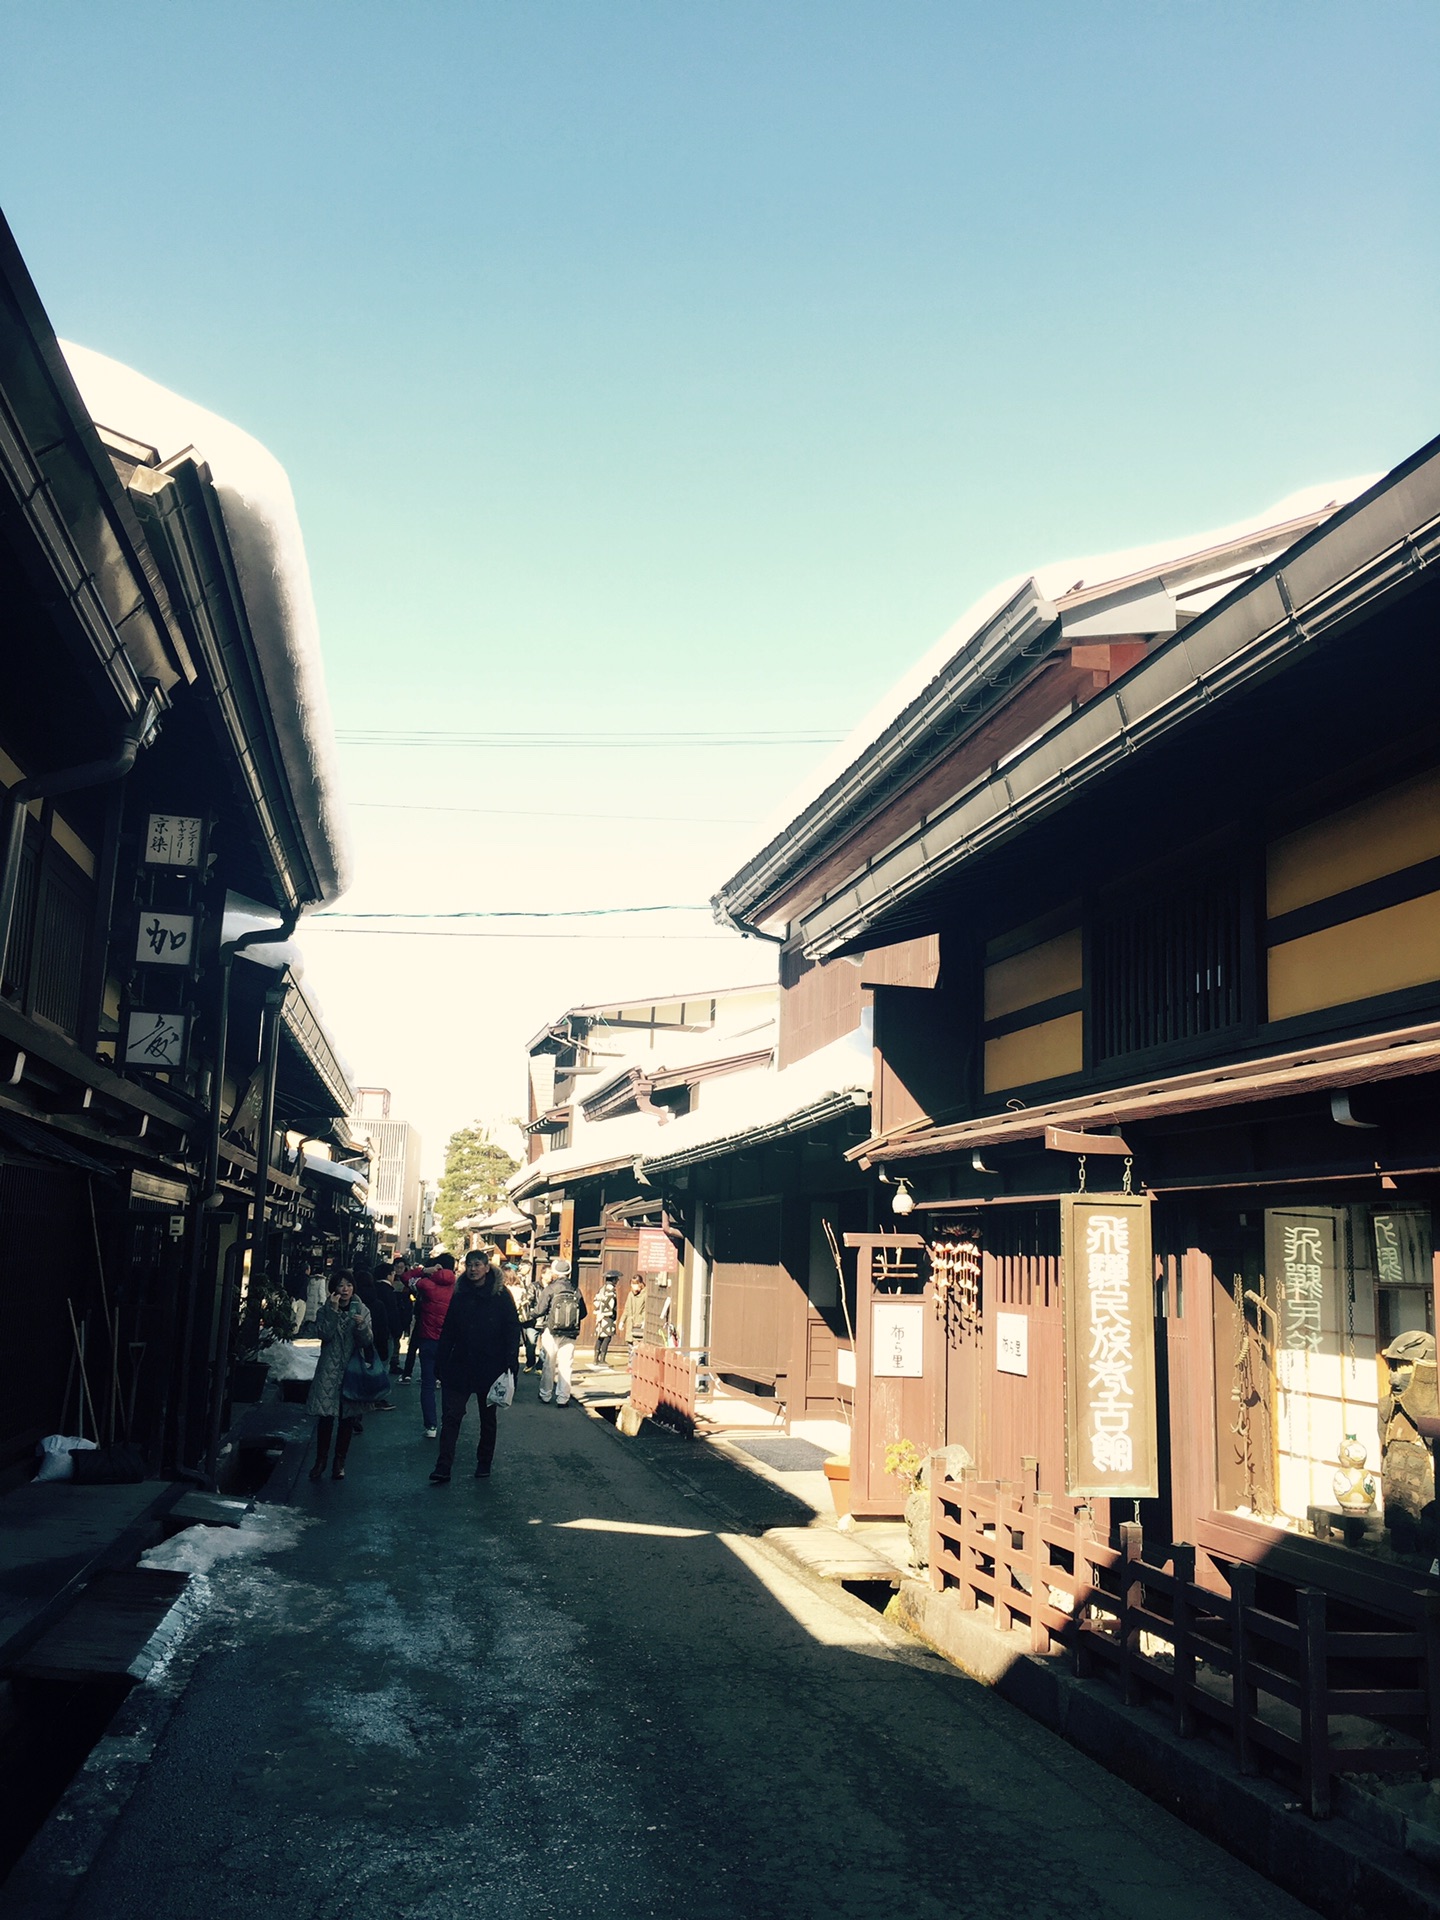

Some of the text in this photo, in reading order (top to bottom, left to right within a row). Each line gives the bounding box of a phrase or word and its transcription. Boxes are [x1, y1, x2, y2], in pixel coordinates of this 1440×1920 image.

[150, 817, 170, 853] 京染
[176, 819, 188, 858] ギャラリー
[186, 819, 200, 866] アンティーク
[145, 918, 188, 955] 加
[890, 1324, 905, 1369] 布ら里
